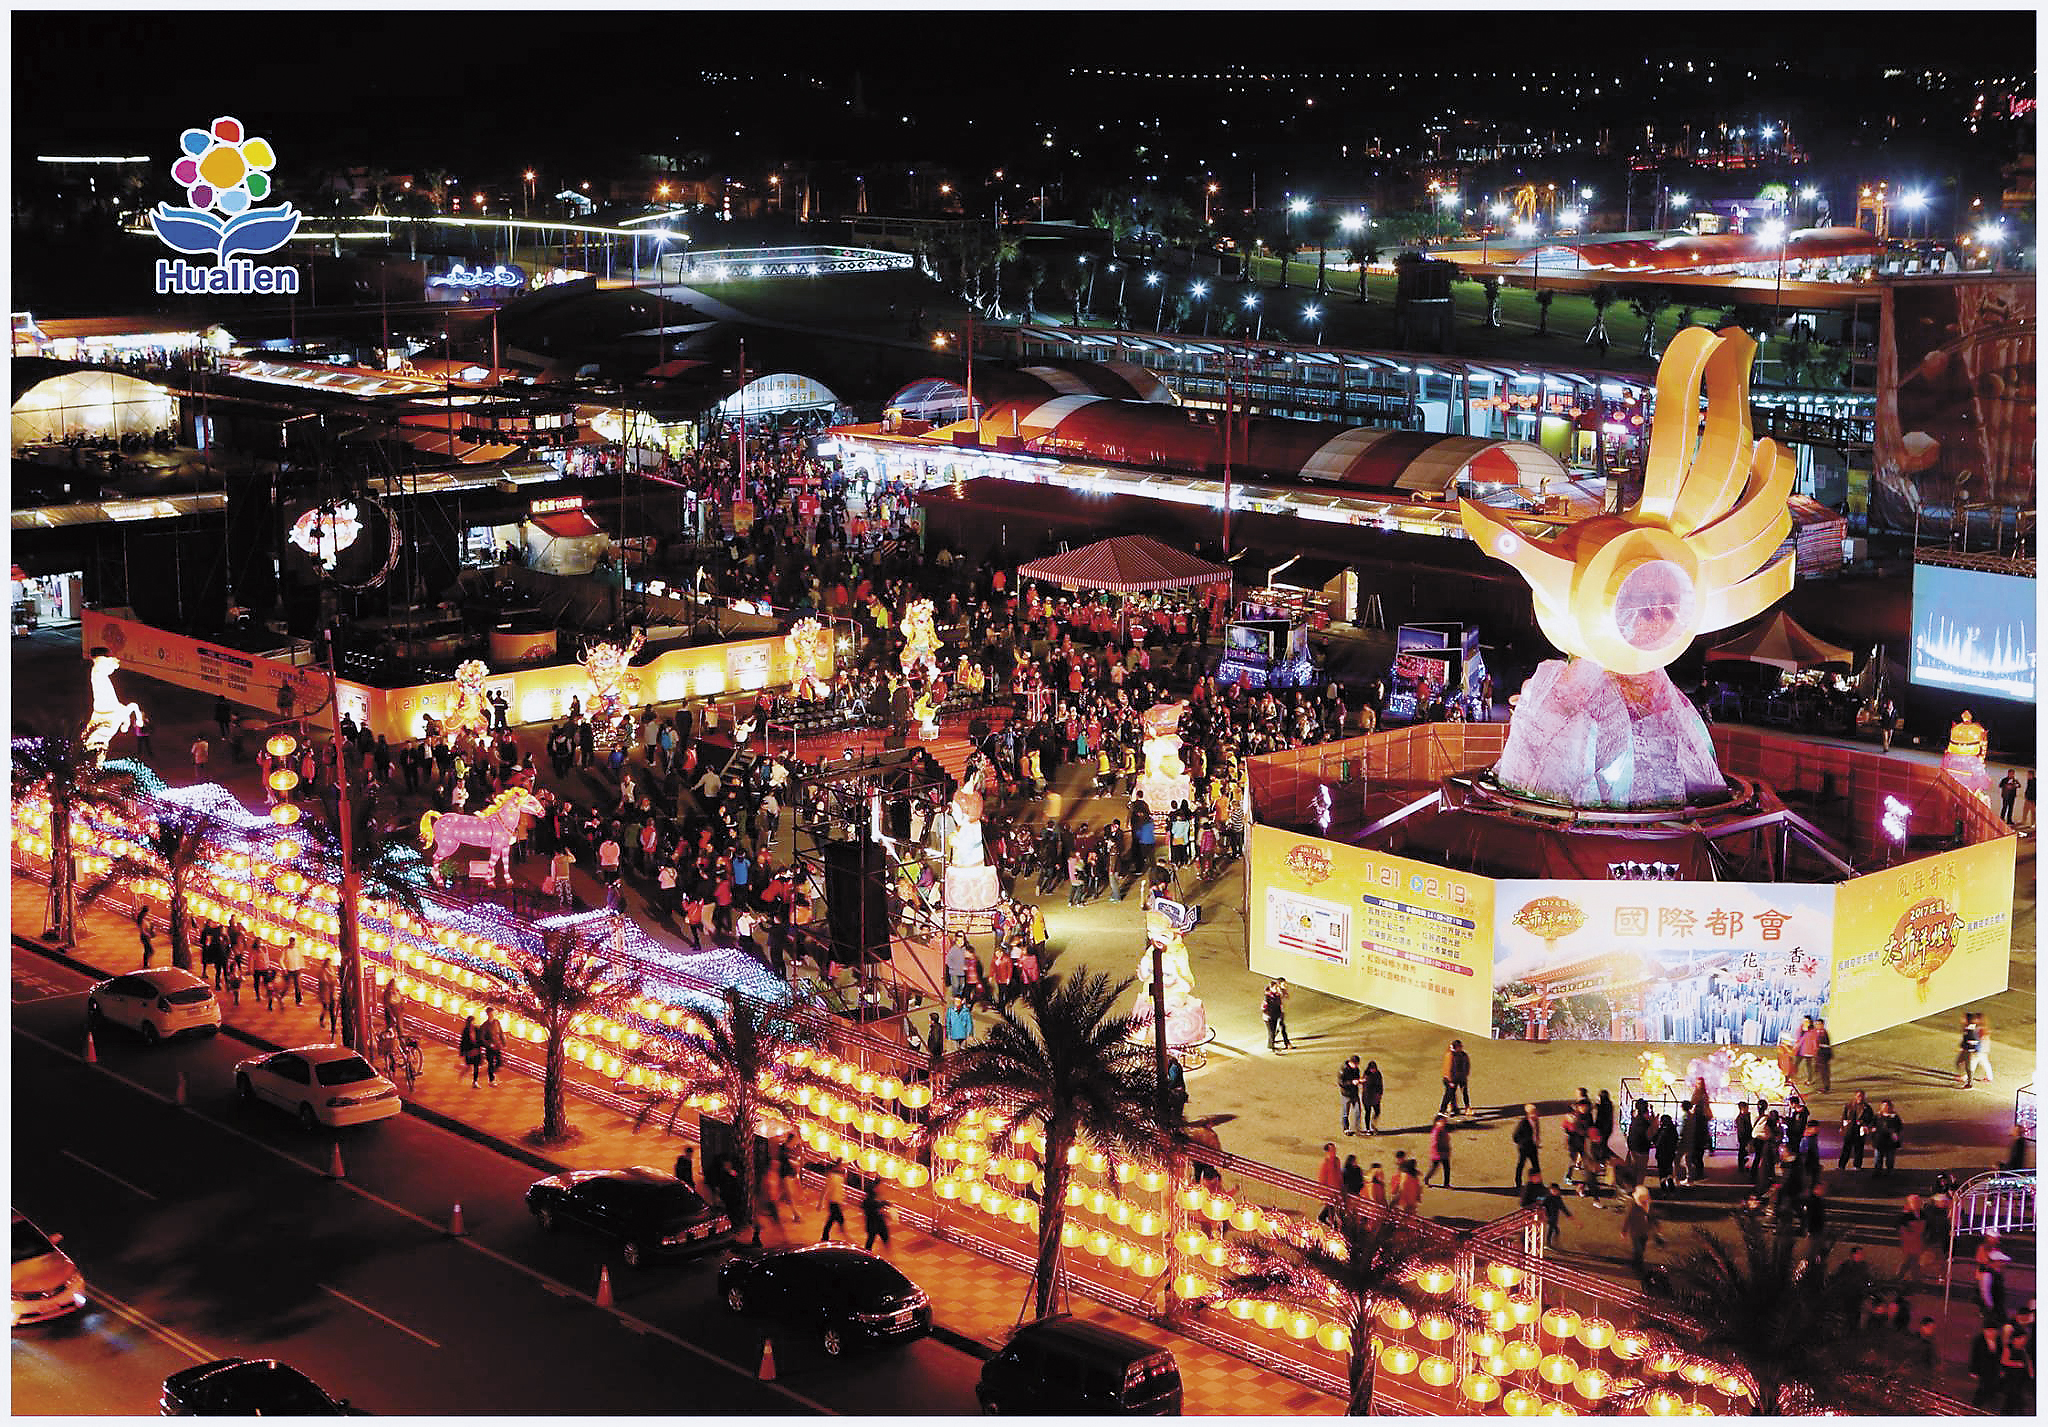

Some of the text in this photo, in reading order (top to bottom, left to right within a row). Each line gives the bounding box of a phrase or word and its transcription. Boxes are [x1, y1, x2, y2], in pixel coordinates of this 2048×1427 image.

[1366, 864, 1466, 904] 1.21 2.19
[1614, 906, 1792, 941] 國際都會
[1882, 915, 1965, 967] 太平洋燈會
[1743, 952, 1764, 981] 花蓮
[1783, 946, 1805, 976] 香港
